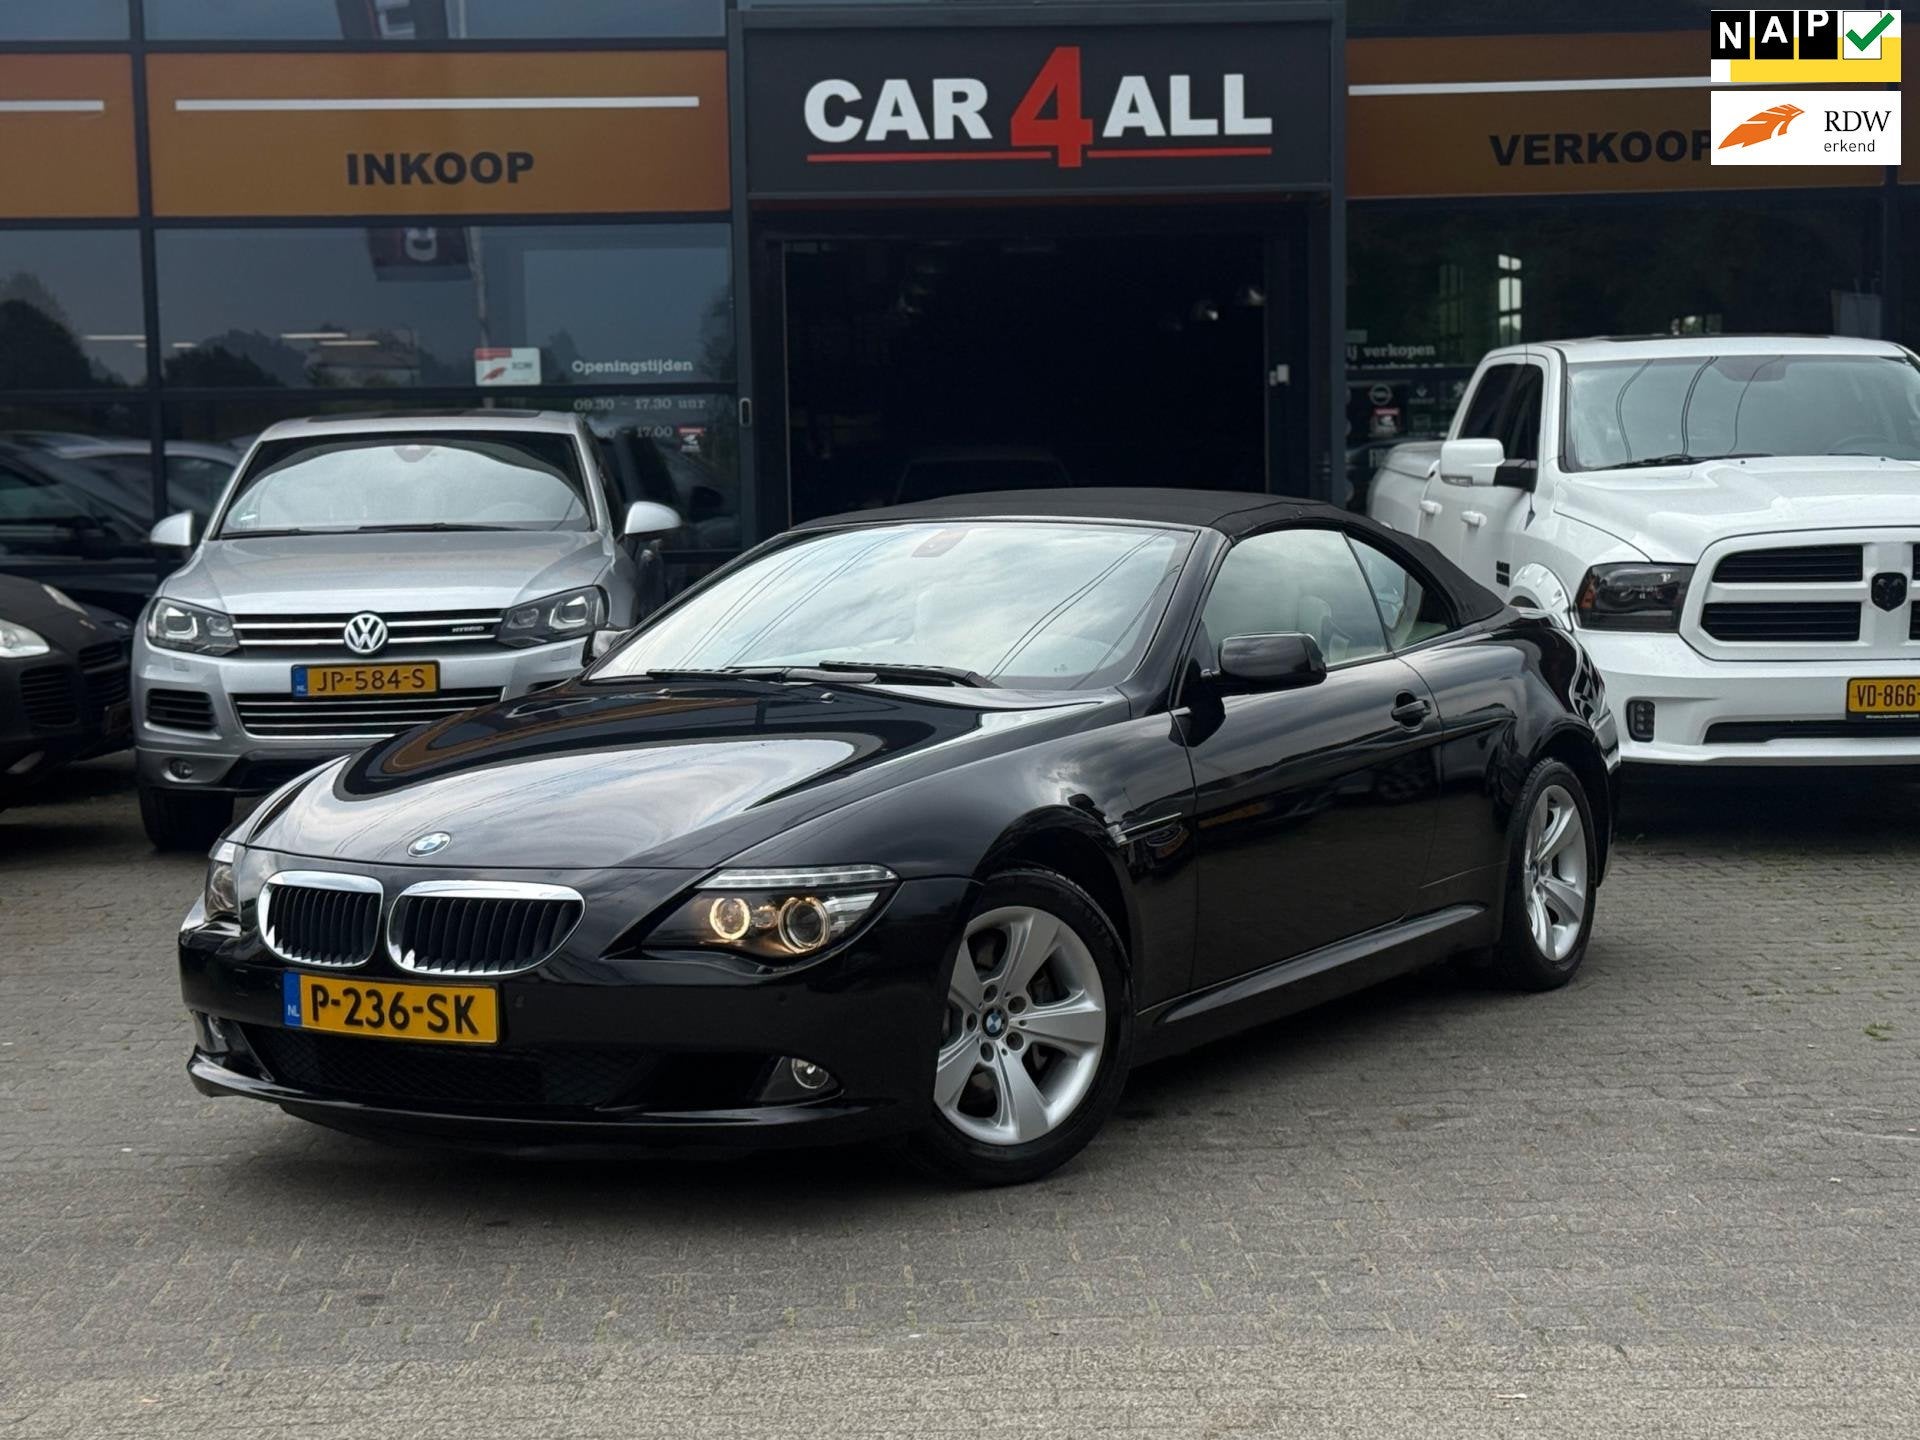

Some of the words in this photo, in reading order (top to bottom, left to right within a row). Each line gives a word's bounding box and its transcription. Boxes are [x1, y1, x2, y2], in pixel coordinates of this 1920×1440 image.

[804, 78, 992, 143] CAR
[1010, 46, 1093, 168] 4
[1103, 73, 1273, 138] ALL
[346, 151, 535, 186] INKOOP
[1363, 344, 1435, 358] verkopen
[571, 359, 693, 376] Openingstijden
[573, 398, 615, 411] 09.30
[634, 398, 672, 410] 17.30
[678, 398, 707, 409] uur
[636, 426, 673, 438] 17.00
[316, 668, 426, 692] JP-584-S
[287, 1004, 300, 1017] NL
[311, 984, 479, 1035] P-236-SK
